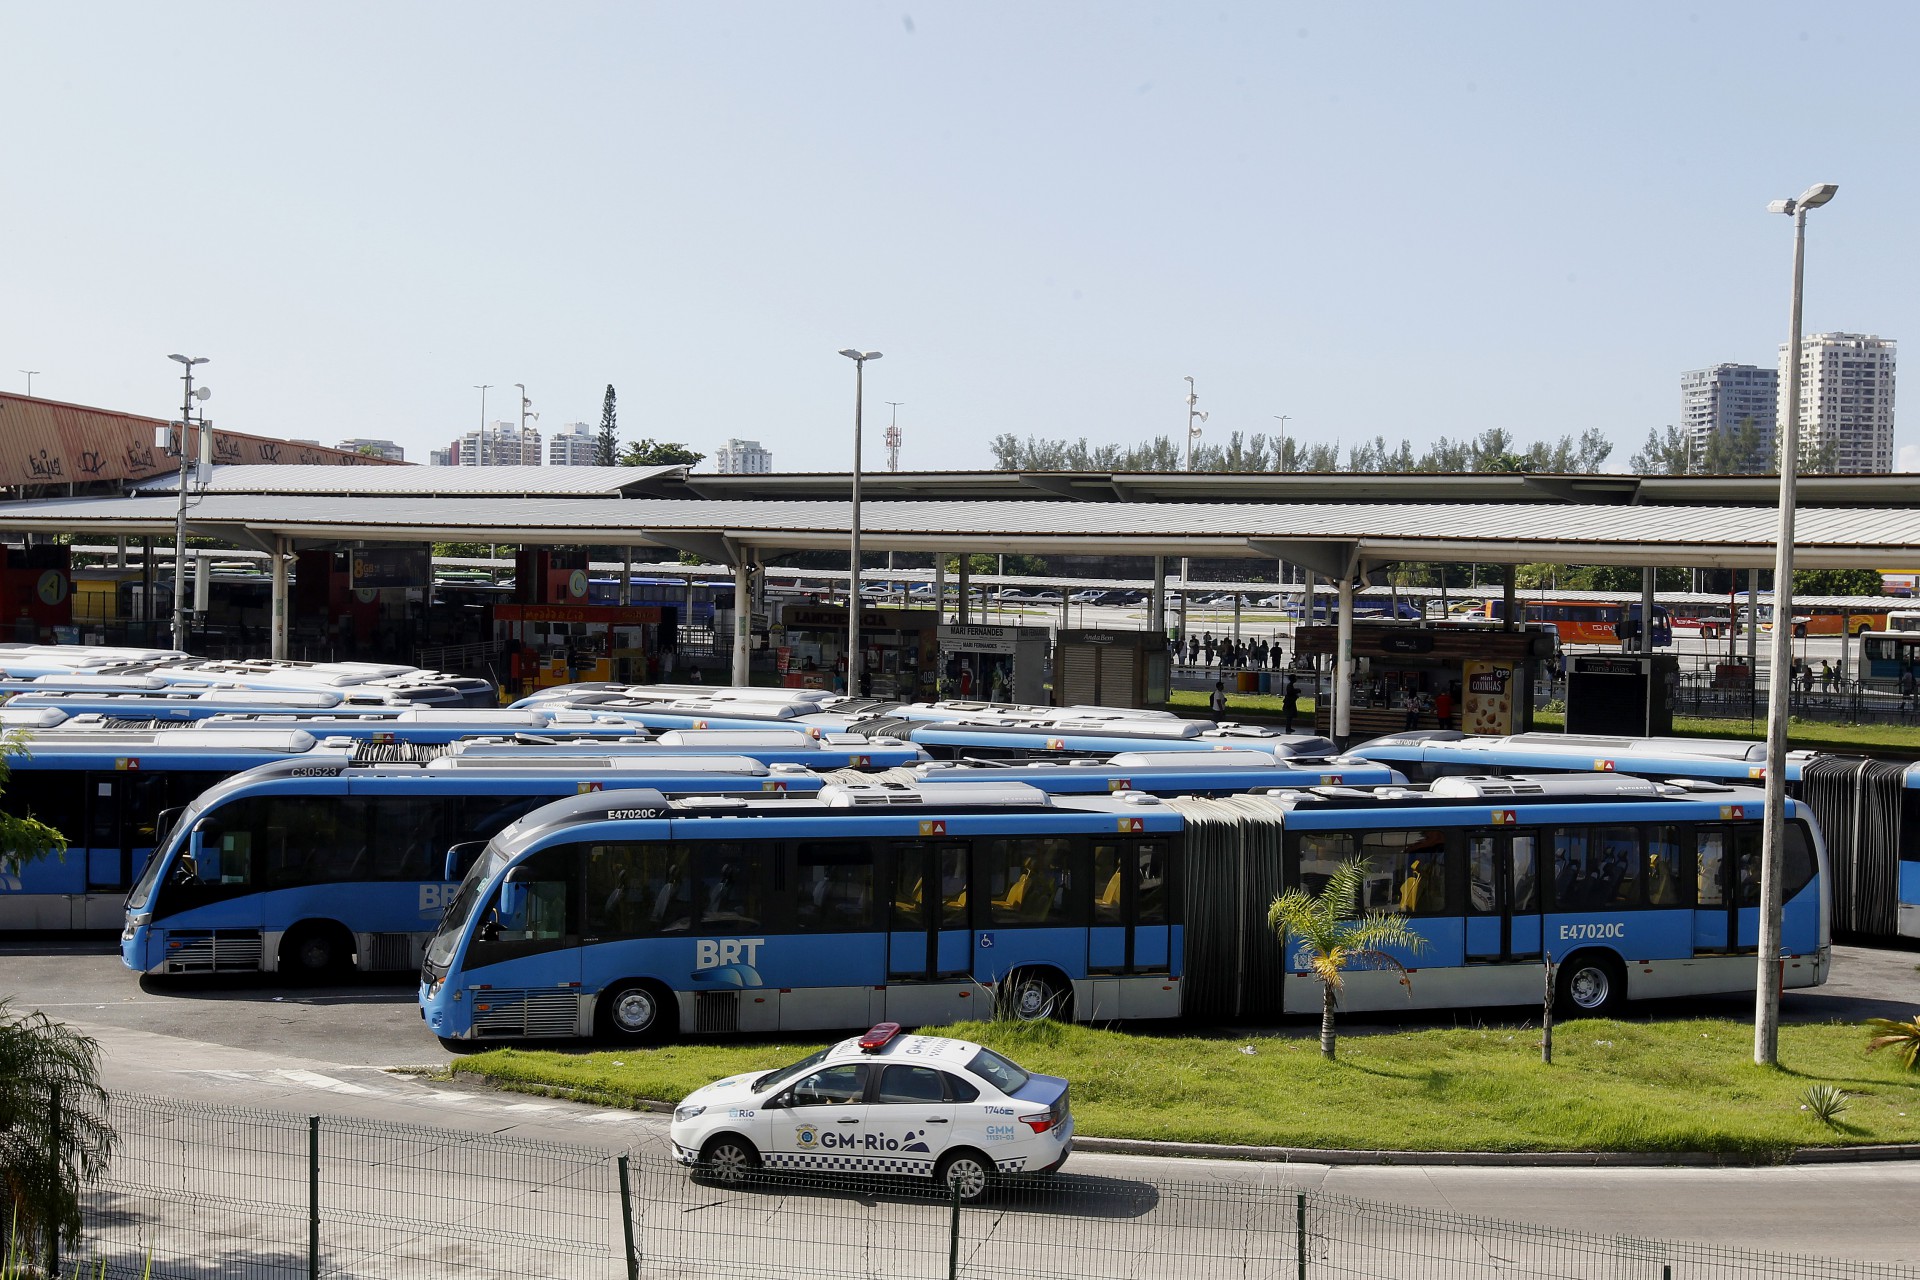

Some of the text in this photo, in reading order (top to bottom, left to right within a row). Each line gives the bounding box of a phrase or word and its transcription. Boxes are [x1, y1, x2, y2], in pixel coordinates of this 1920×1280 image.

[795, 611, 849, 625] LANCHE
[951, 627, 1004, 636] MARI FERNANDES
[1472, 680, 1502, 691] COXINHAS
[291, 767, 337, 777] C30523
[607, 808, 657, 820] E47020C
[419, 884, 461, 910] BR
[1560, 923, 1625, 940] E47020C
[697, 938, 764, 970] BRT
[739, 1109, 755, 1118] Rio
[984, 1105, 1005, 1115] 1746
[986, 1125, 1014, 1134] GMM
[821, 1131, 899, 1151] GM-Rio
